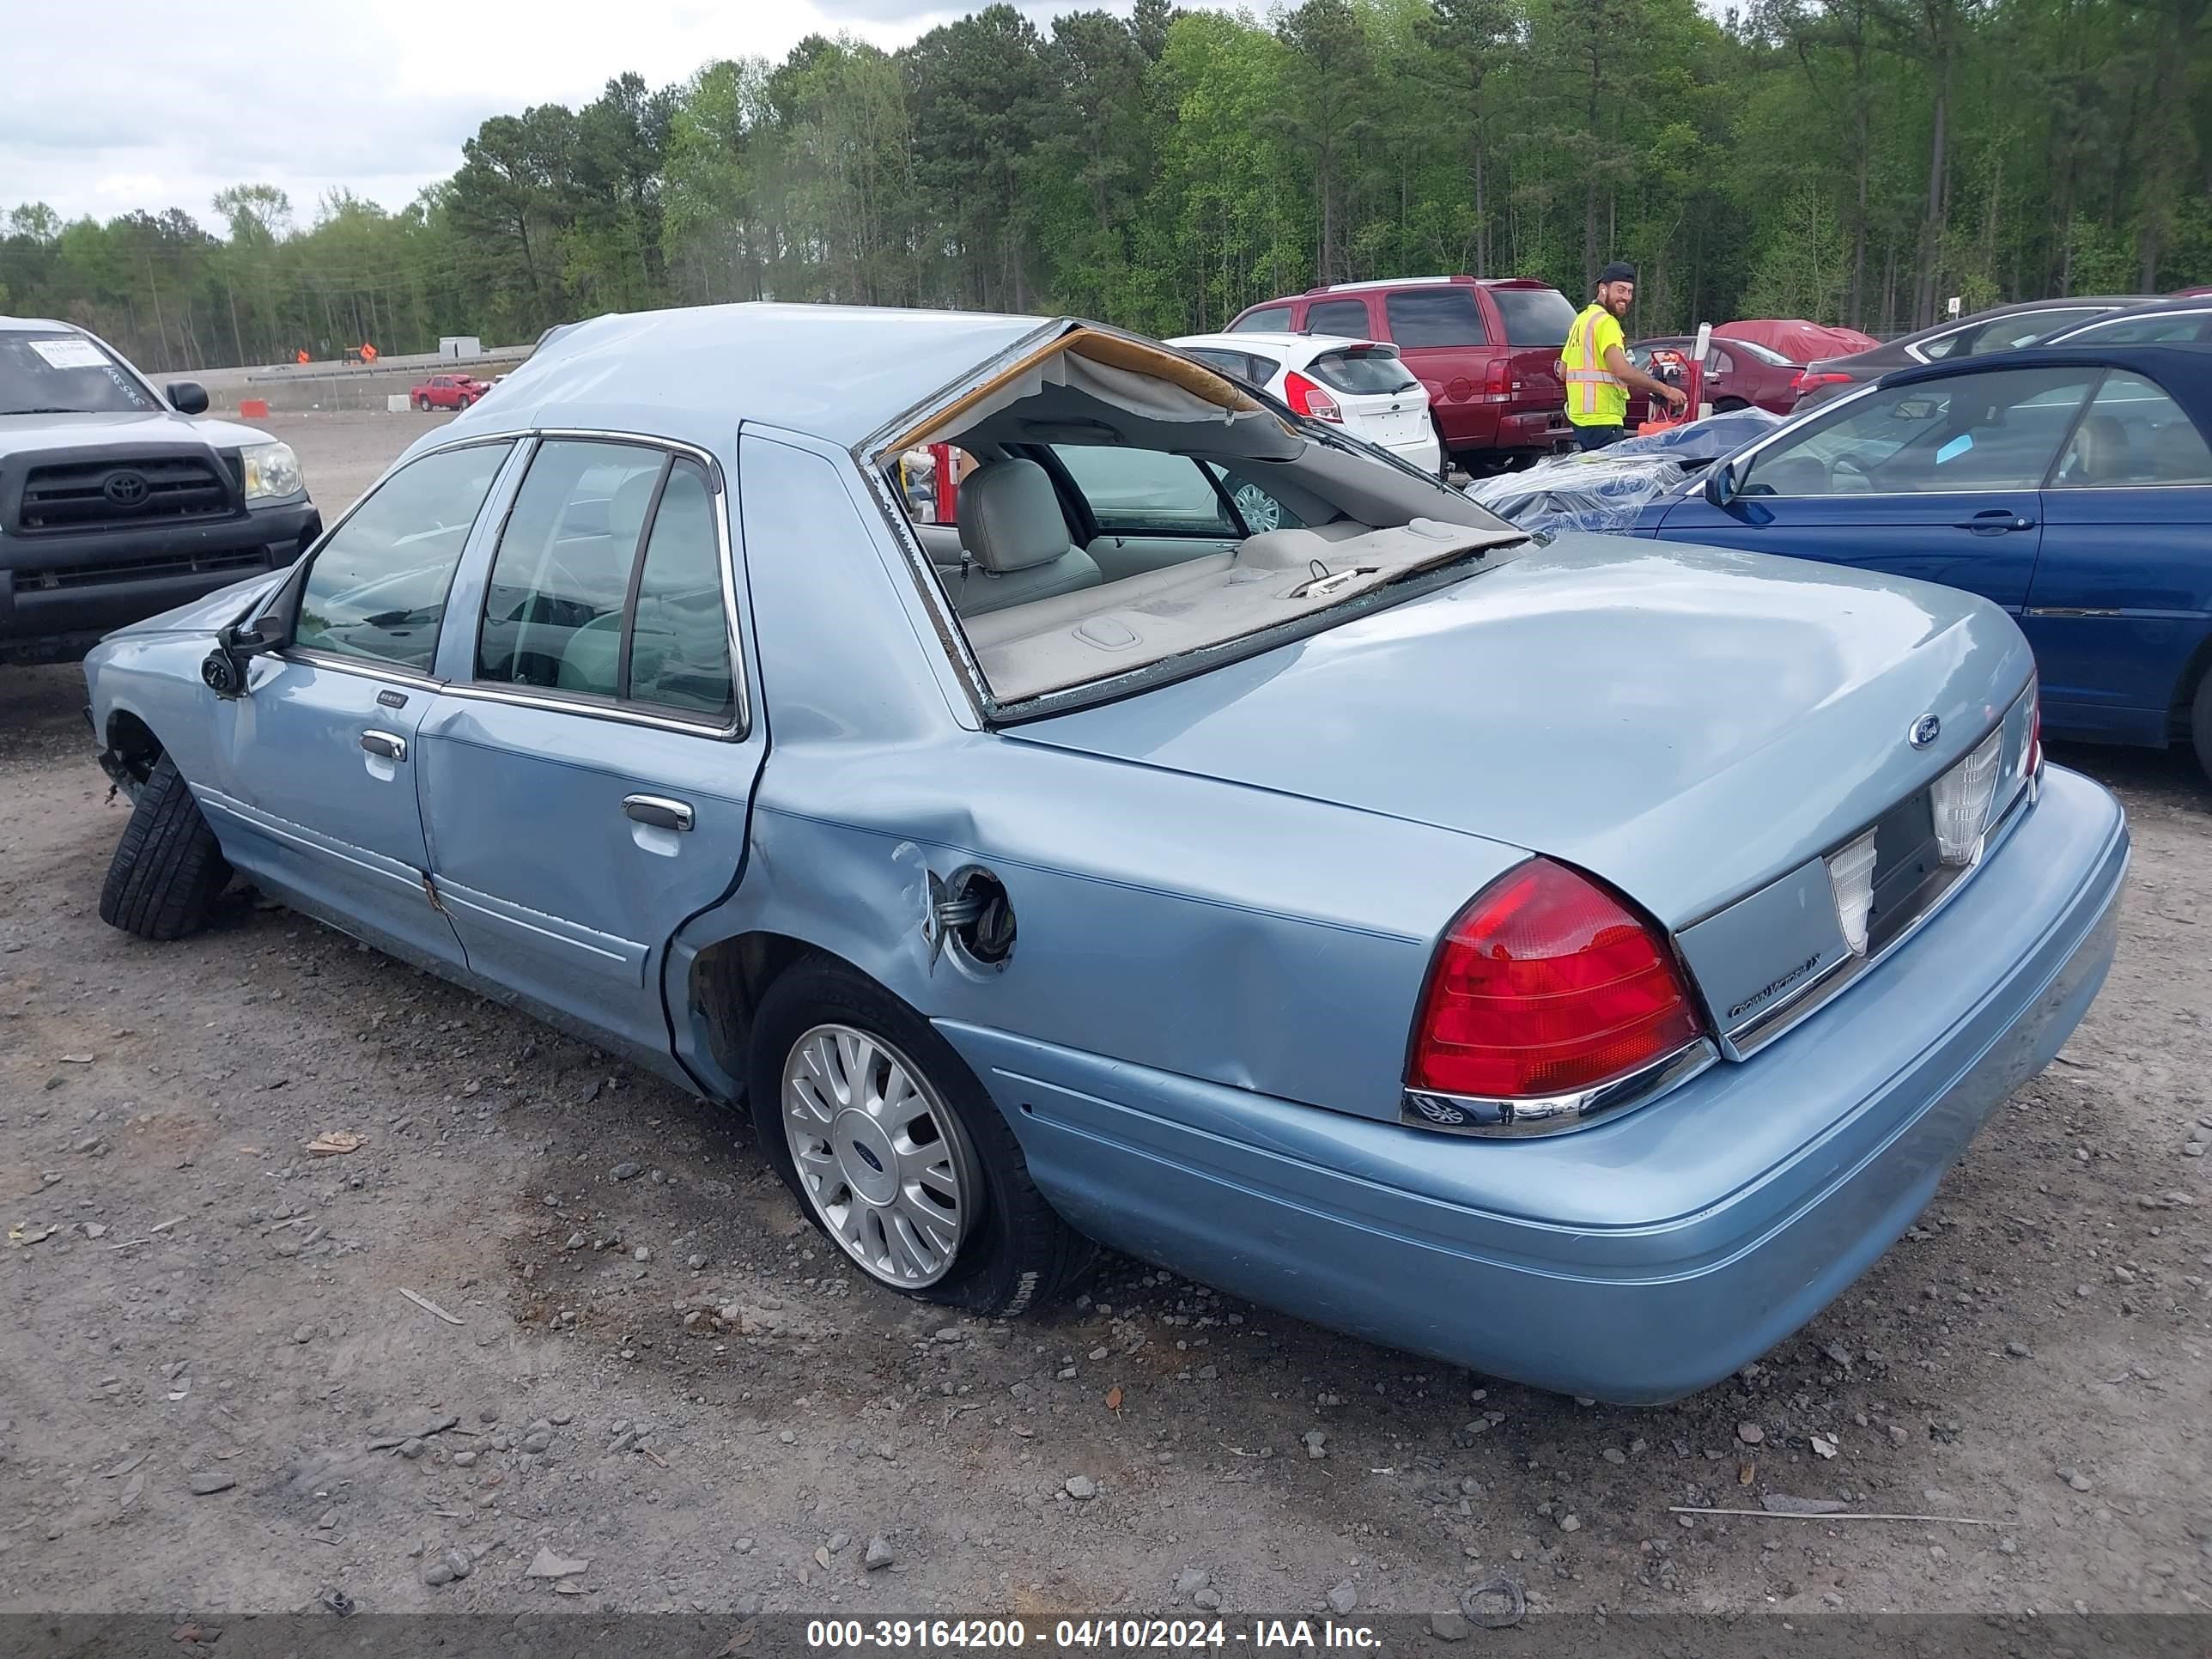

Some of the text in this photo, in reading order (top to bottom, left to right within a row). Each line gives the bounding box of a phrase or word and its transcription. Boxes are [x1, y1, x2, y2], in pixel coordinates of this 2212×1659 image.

[1950, 300, 1957, 310] A
[1920, 720, 1938, 742] Ford
[1729, 988, 1769, 1018] CROWN
[1769, 965, 1807, 993] VICTORIA
[858, 1147, 878, 1167] Ford
